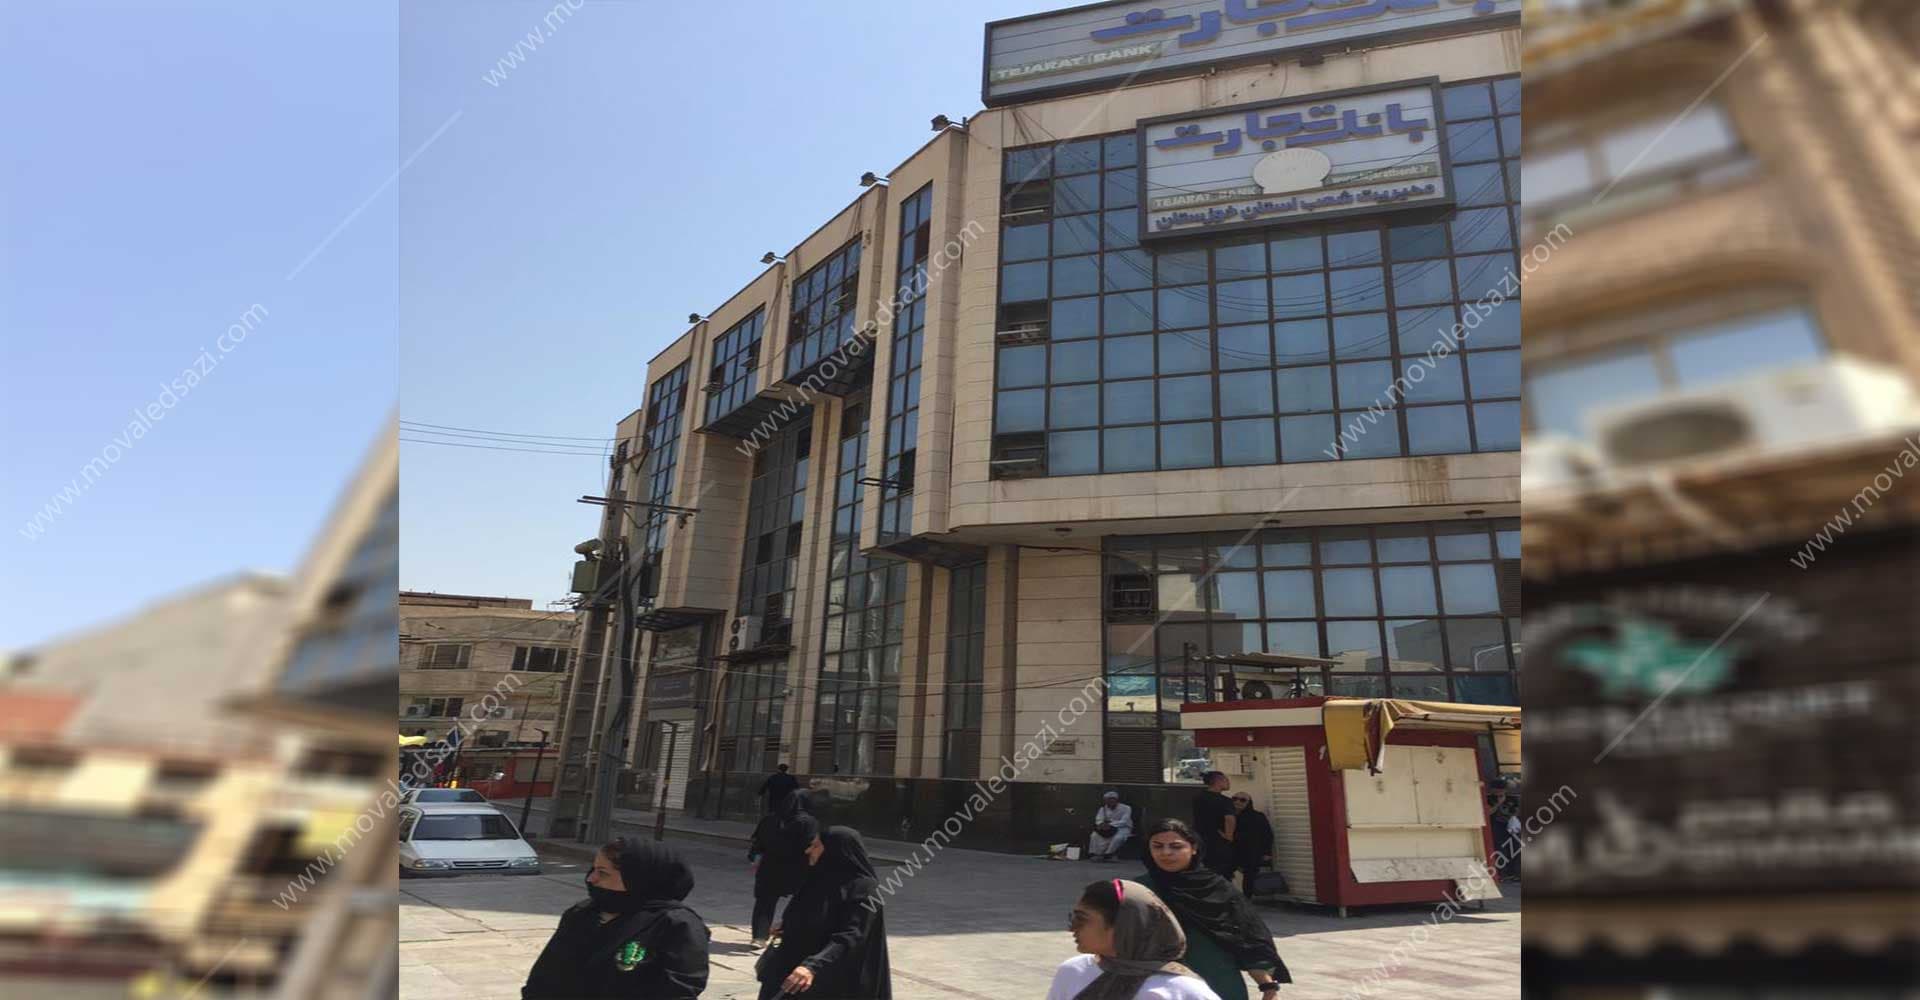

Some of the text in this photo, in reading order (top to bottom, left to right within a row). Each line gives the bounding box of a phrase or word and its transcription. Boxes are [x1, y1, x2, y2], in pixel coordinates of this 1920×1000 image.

[998, 43, 1152, 78] TEJARAT BANK
[1154, 104, 1338, 156] تجارت
[1240, 196, 1298, 220] استان
[1299, 190, 1354, 212] شعب
[1156, 205, 1239, 231] خوزستان
